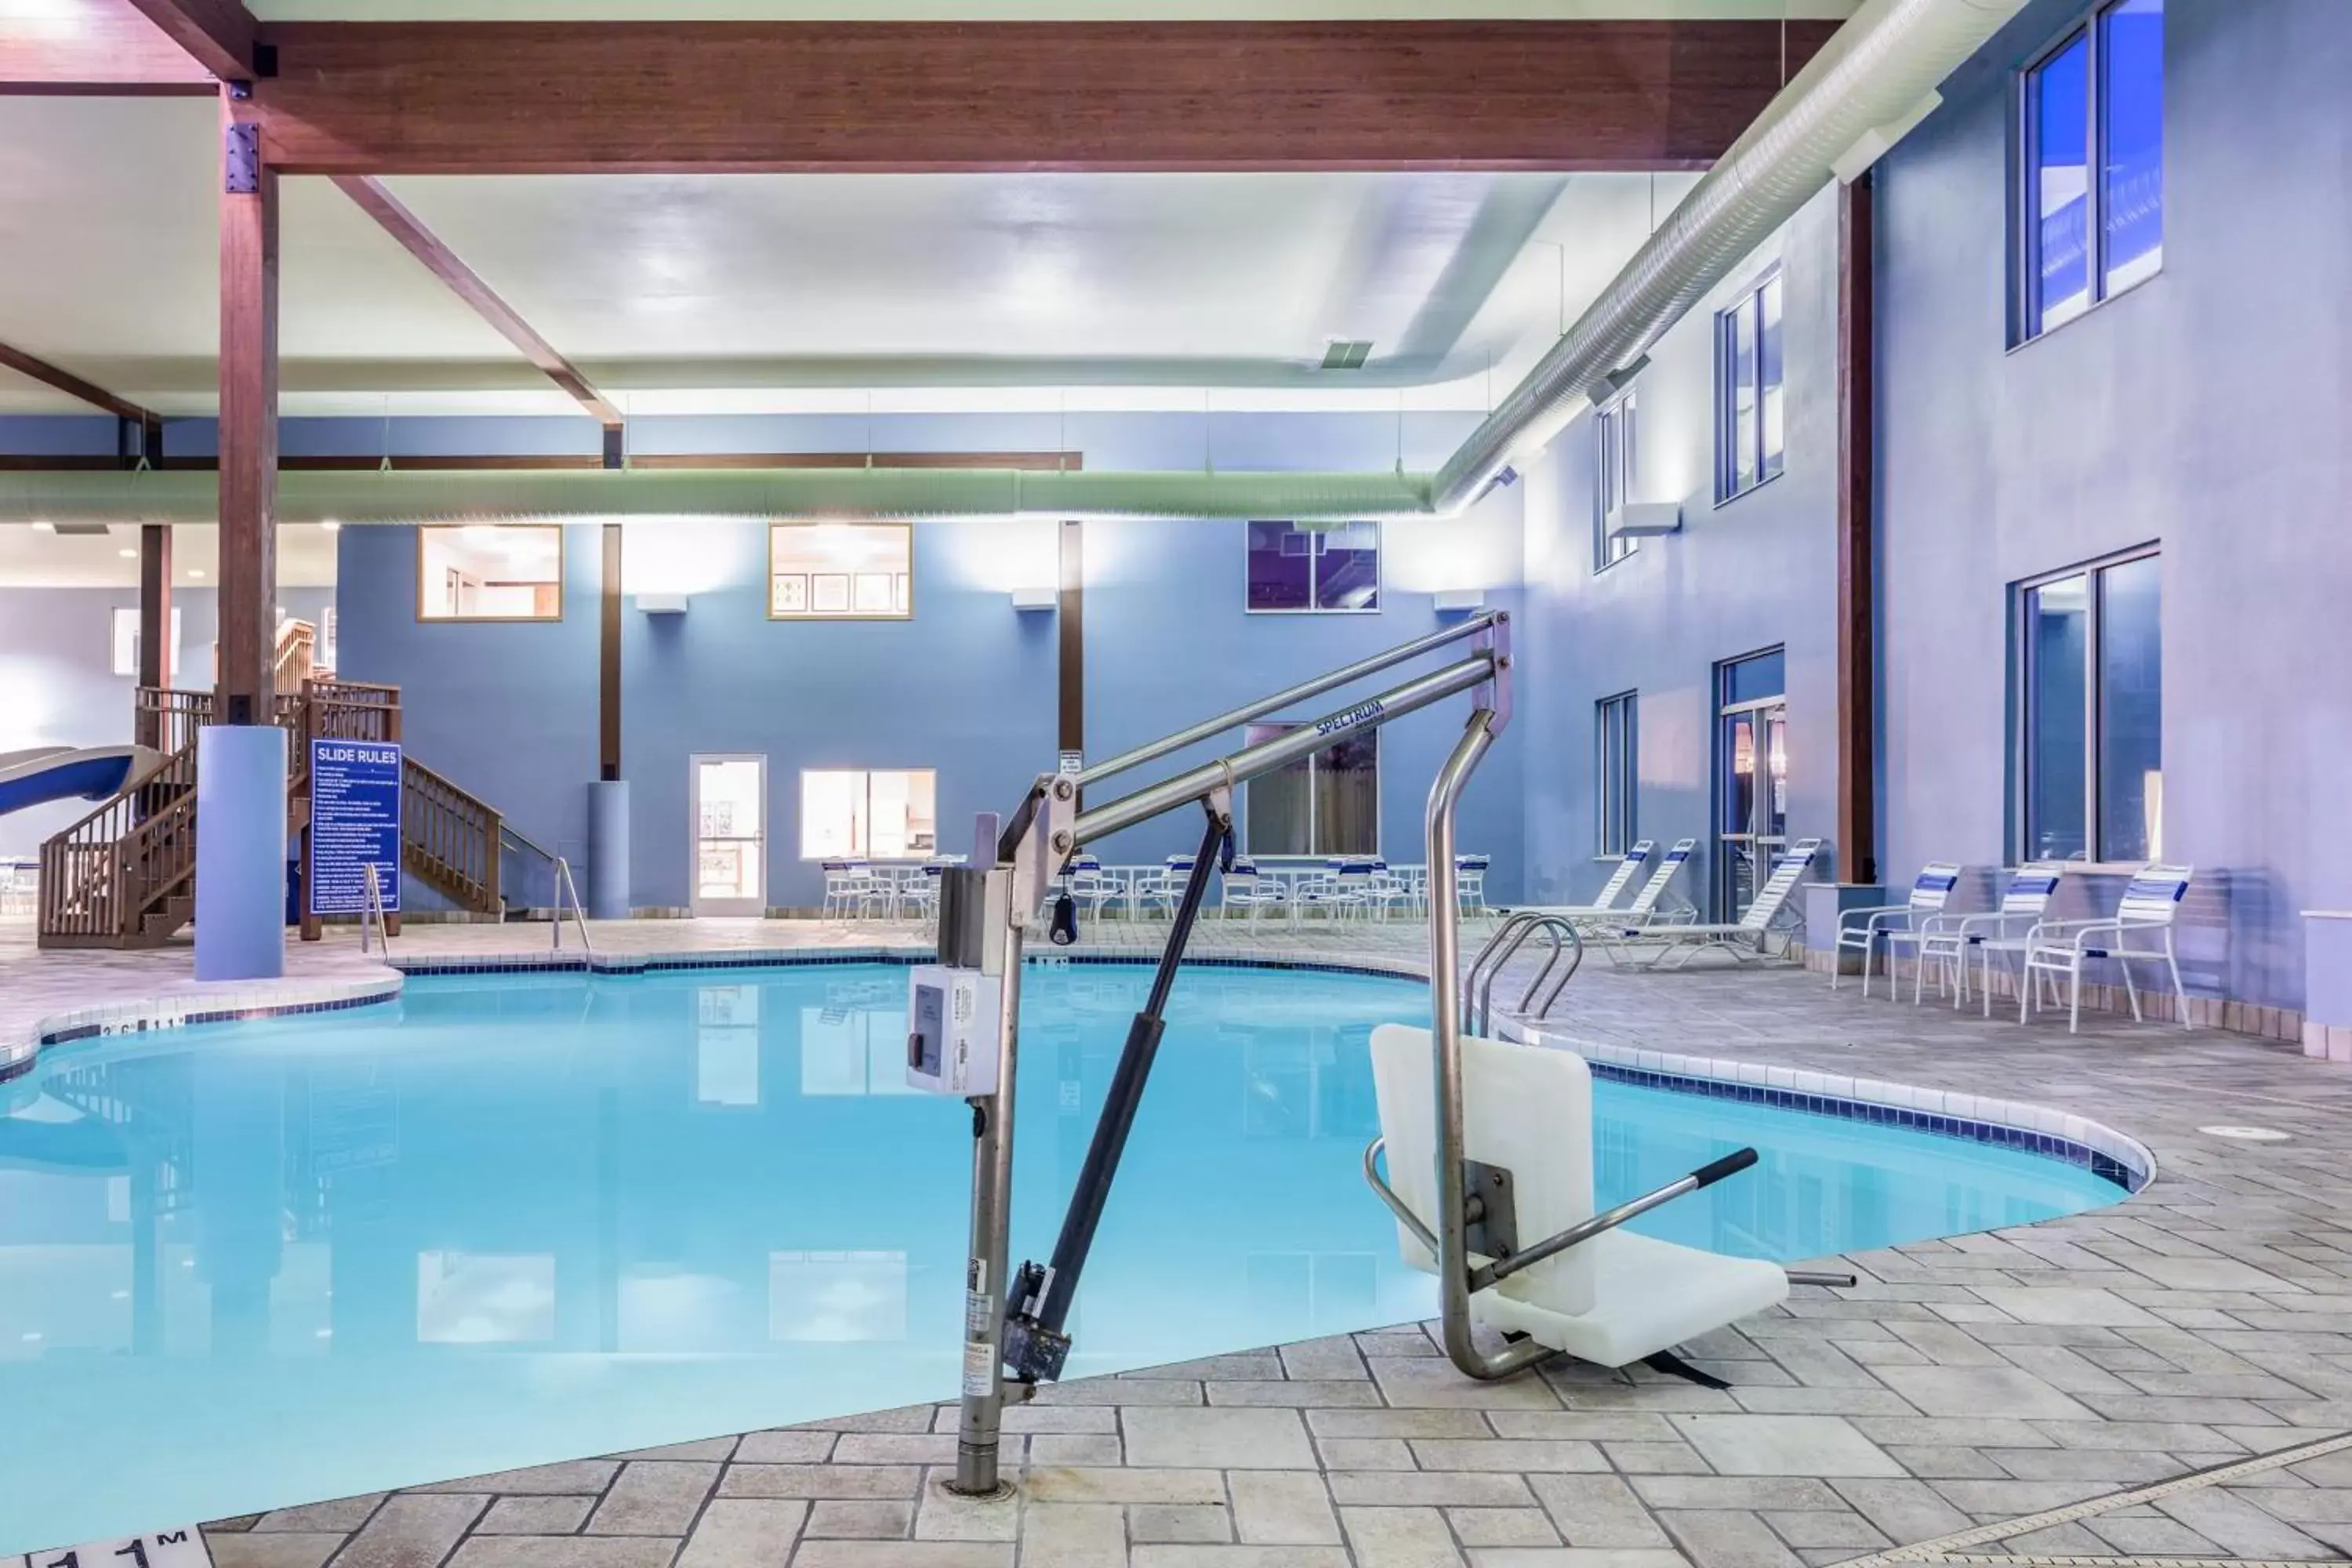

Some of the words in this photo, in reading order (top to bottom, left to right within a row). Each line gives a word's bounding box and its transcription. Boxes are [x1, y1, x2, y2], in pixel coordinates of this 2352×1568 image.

[1316, 700, 1384, 736] SPECTRUM
[318, 747, 354, 762] SLIDE
[358, 750, 397, 764] RULES
